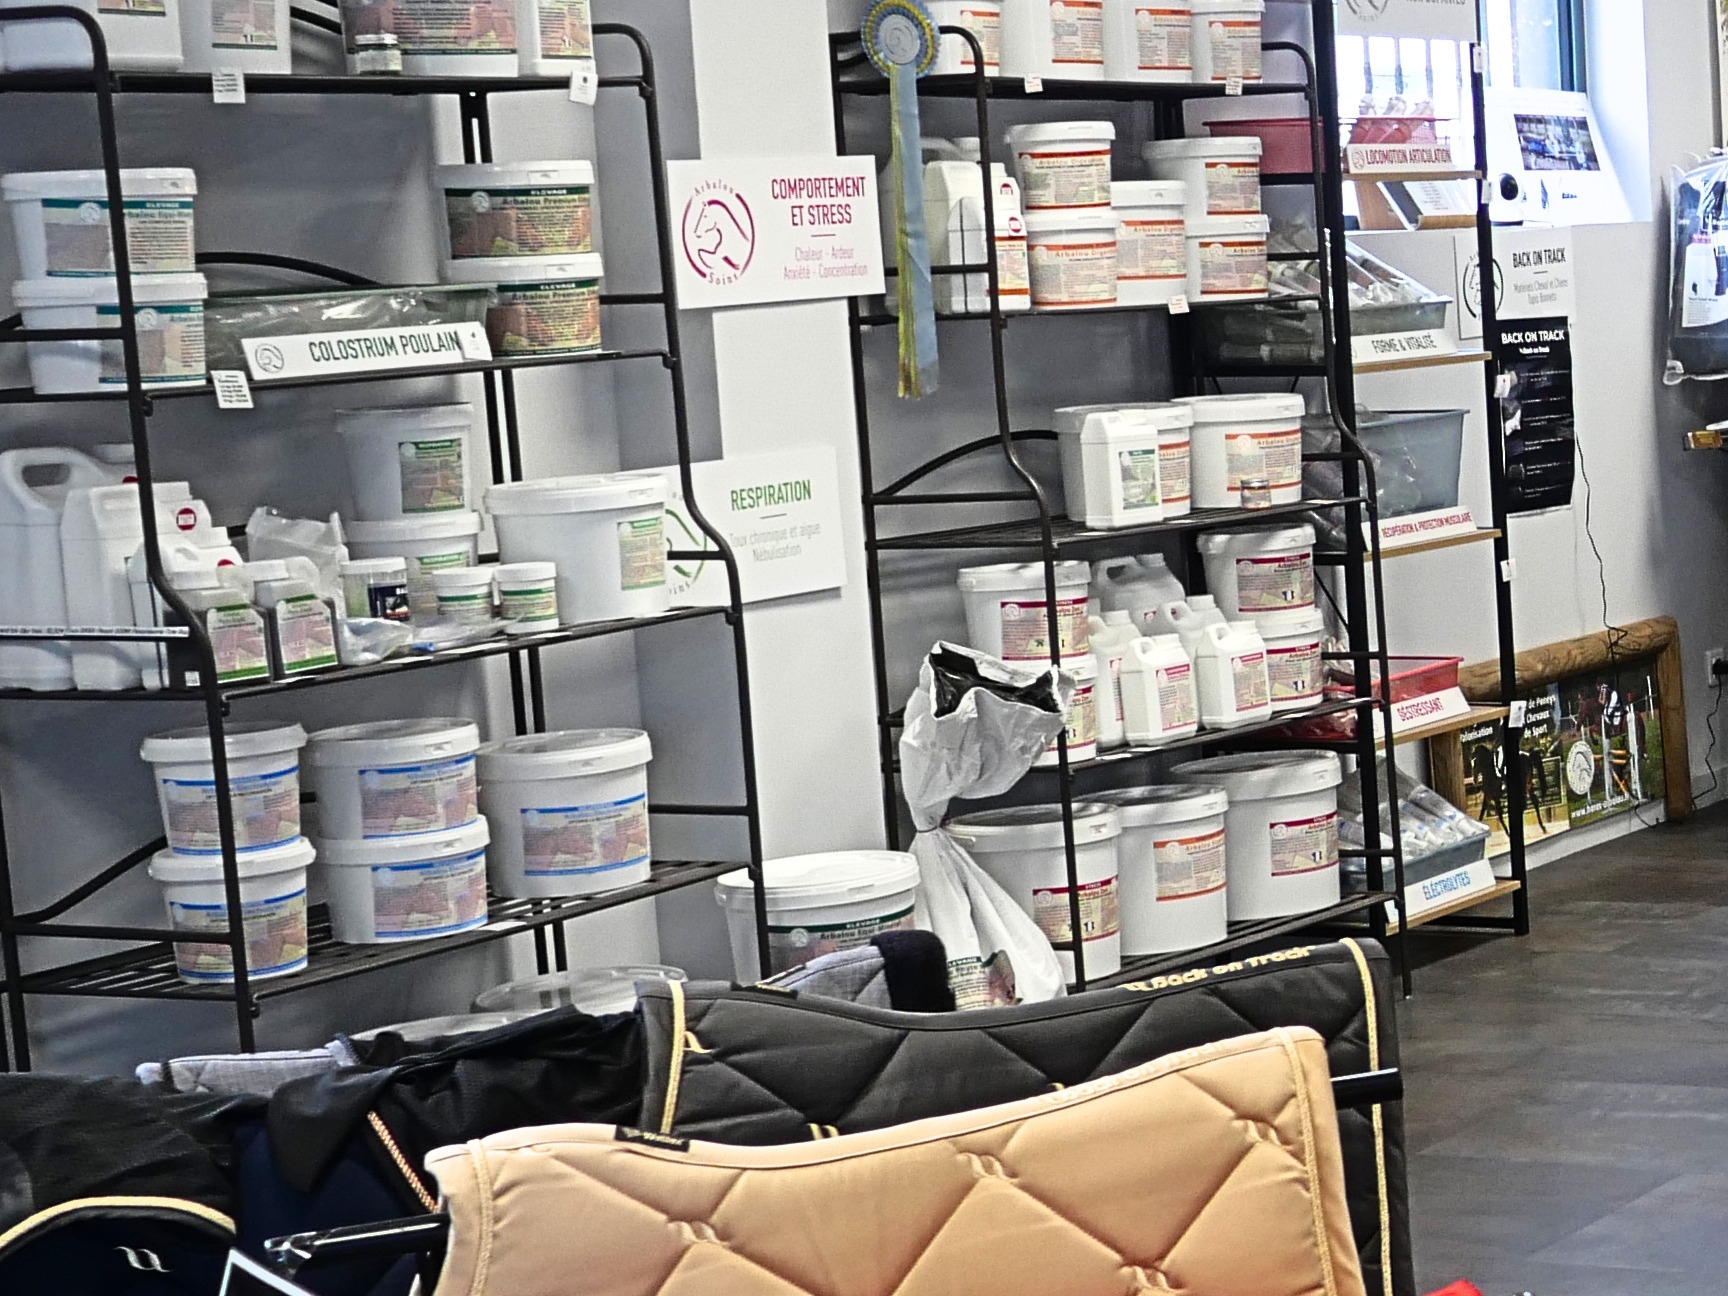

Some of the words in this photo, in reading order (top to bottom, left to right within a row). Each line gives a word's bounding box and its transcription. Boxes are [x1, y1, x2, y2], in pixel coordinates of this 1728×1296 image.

[1365, 148, 1408, 165] LOCOMOTION
[771, 176, 866, 200] COMPORTEMENT
[790, 204, 805, 227] ET
[808, 204, 853, 226] STRESS
[1512, 252, 1531, 269] BACK
[1533, 250, 1543, 267] ON
[1544, 247, 1566, 265] TRACK
[308, 335, 398, 363] COLOSTRUM
[402, 330, 462, 355] POULAIN
[1501, 331, 1523, 345] BACK
[1524, 330, 1538, 344] ON
[1539, 329, 1565, 342] TRACK
[730, 478, 812, 512] RESPIRATION
[1150, 968, 1208, 990] Back
[1212, 961, 1244, 975] on
[1245, 945, 1316, 968] Track
